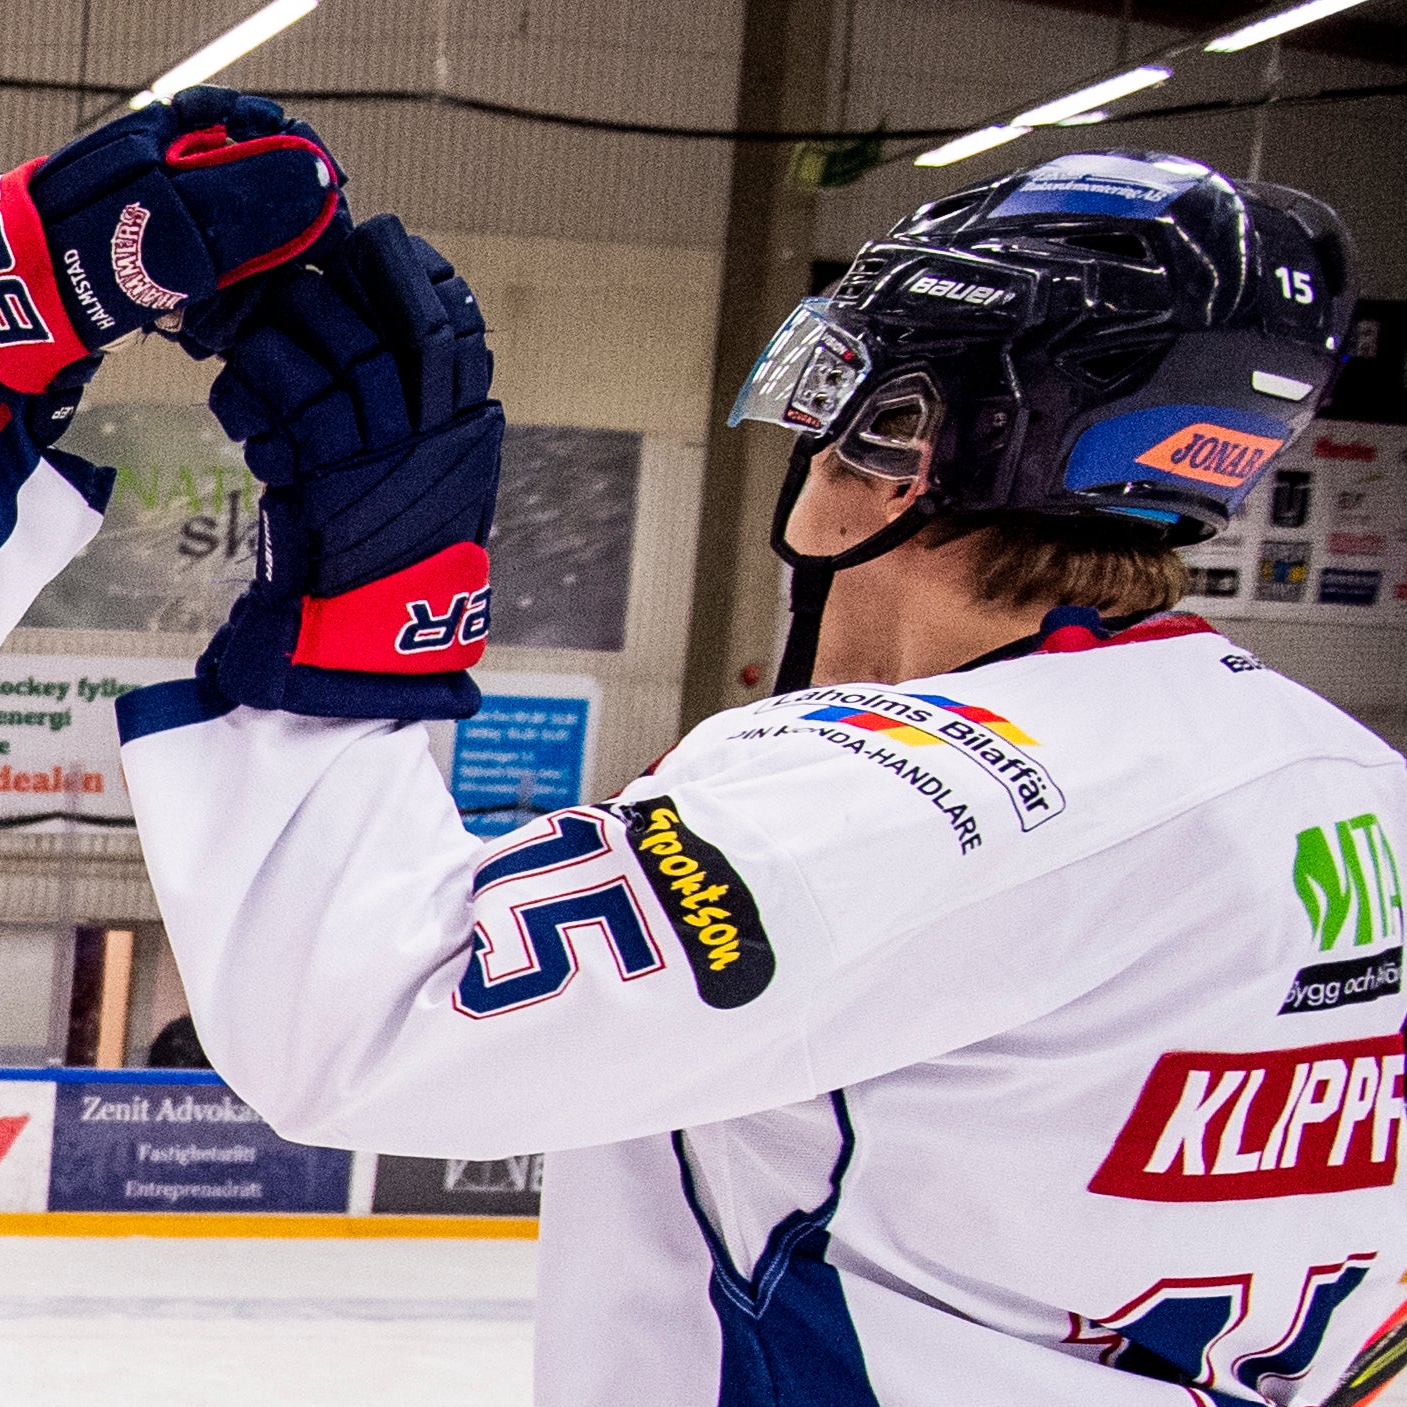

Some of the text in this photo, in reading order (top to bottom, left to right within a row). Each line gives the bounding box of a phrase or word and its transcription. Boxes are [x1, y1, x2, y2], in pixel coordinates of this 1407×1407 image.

[64, 249, 115, 331] HALMSTAD
[910, 275, 1004, 305] BAUER
[1274, 266, 1313, 305] 15
[774, 688, 1050, 814] Laholms Bilaffär
[453, 809, 667, 1020] 15
[639, 807, 741, 972] Sportson
[80, 1095, 149, 1123] Zenit
